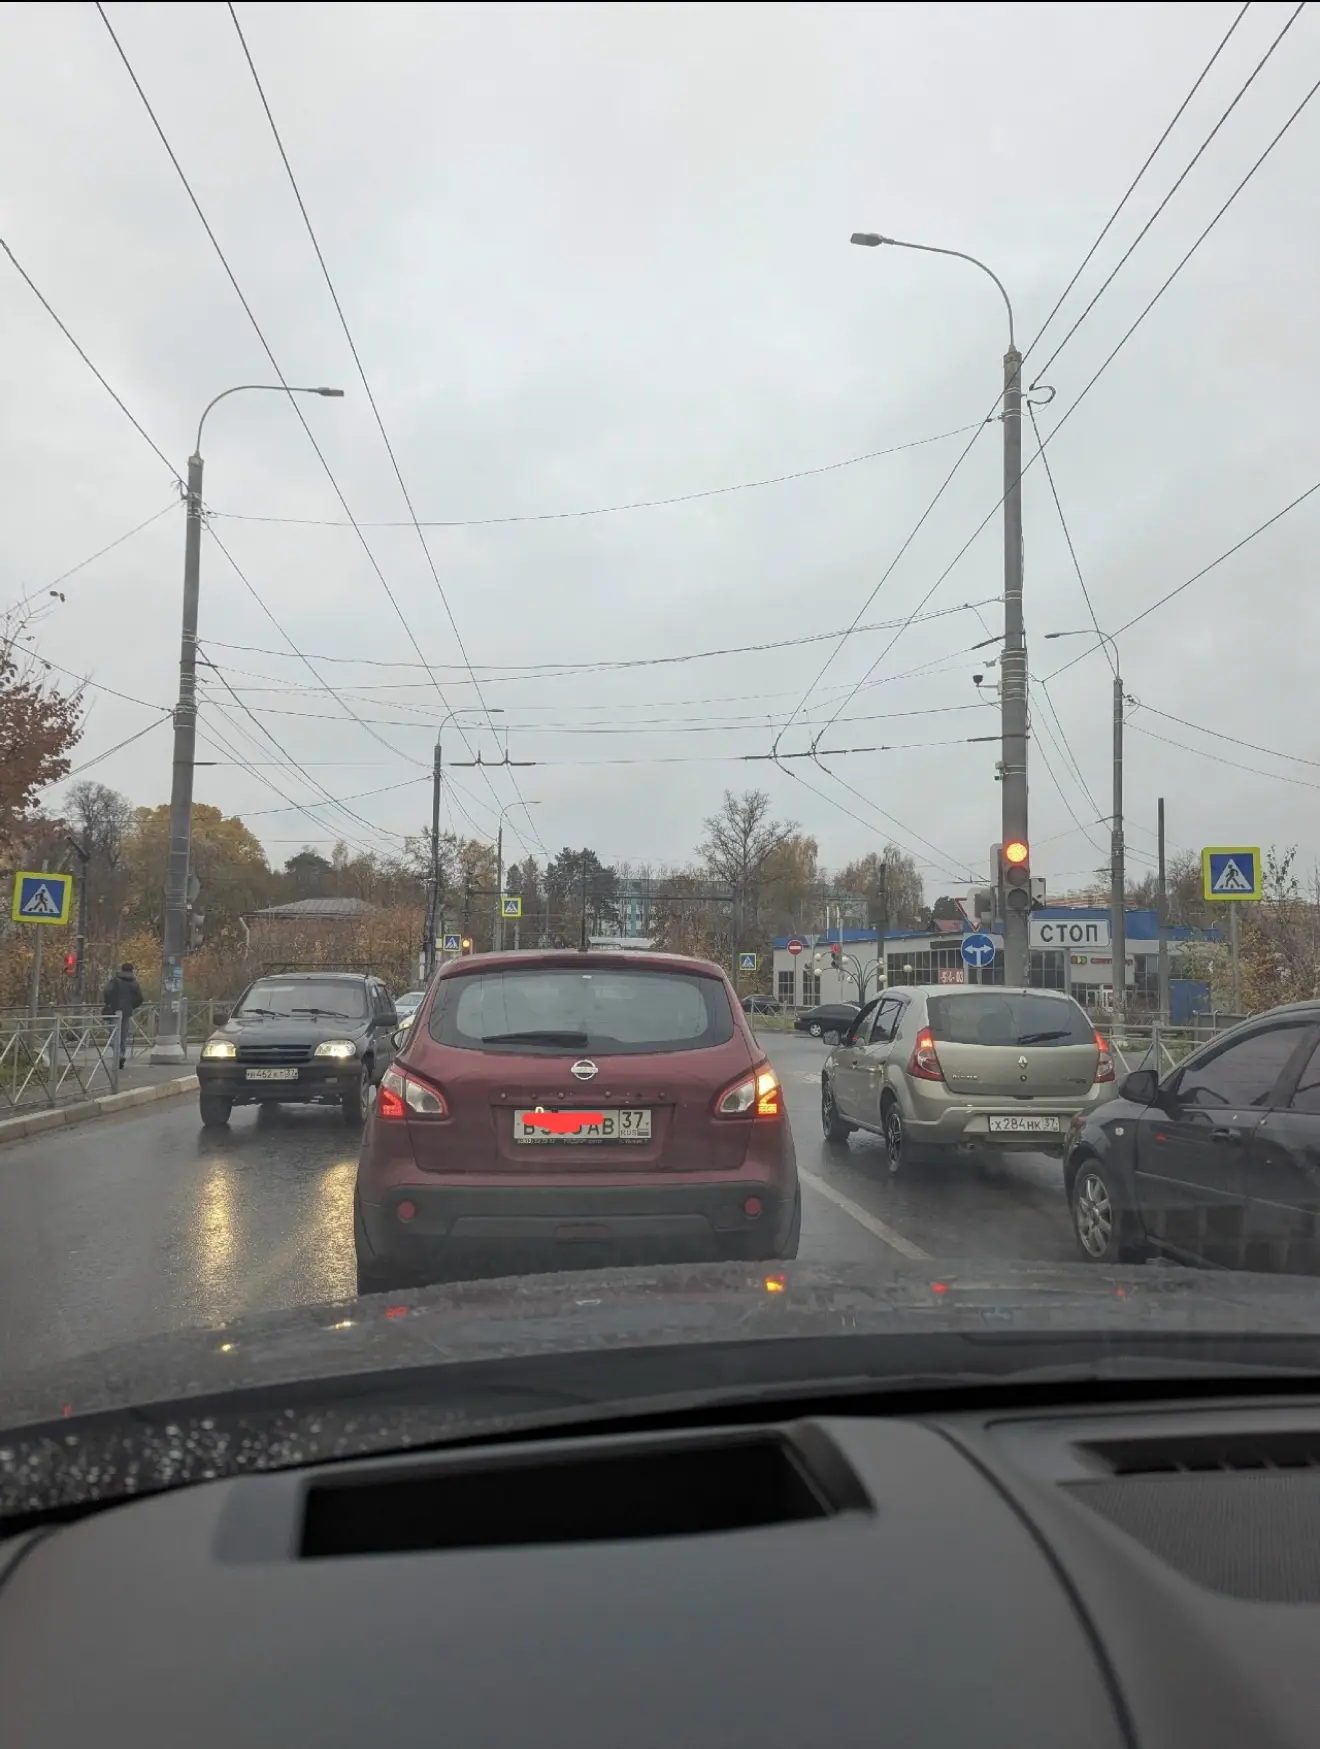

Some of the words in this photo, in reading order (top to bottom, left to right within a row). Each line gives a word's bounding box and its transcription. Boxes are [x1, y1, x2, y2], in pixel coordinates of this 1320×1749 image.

[1040, 924, 1098, 942] СТОП
[523, 1117, 615, 1135] ВАВ
[622, 1112, 643, 1128] 37
[1044, 1118, 1055, 1127] 37
